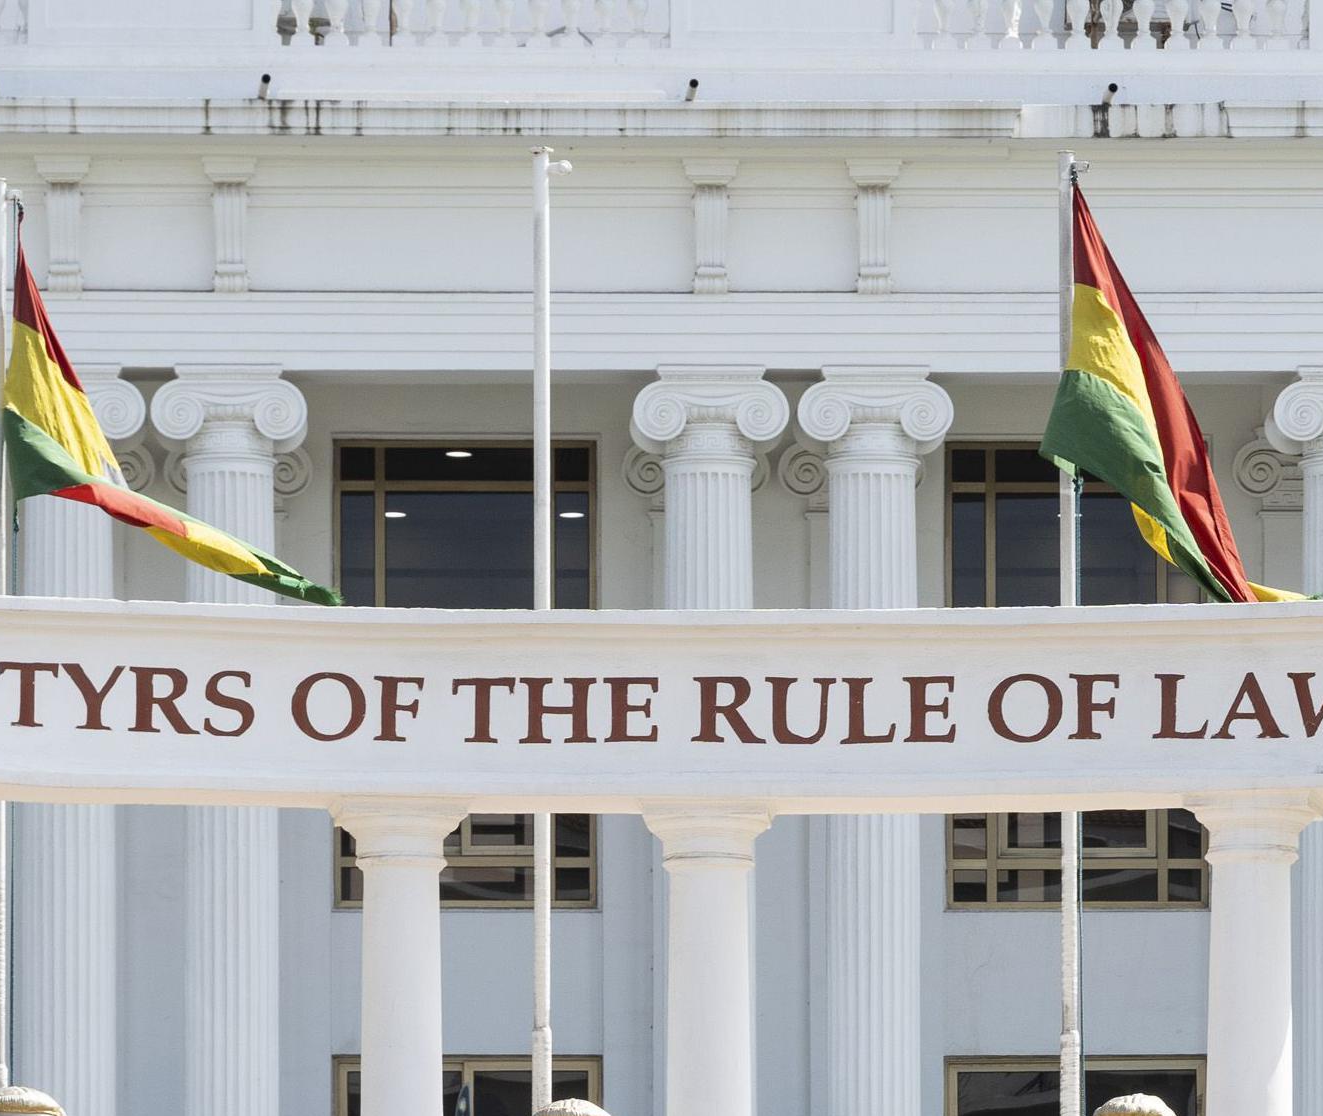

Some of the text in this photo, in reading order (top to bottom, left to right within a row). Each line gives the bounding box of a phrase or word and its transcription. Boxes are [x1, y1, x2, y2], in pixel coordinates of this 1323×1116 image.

[289, 671, 426, 743] OF
[449, 675, 661, 745] THE
[691, 674, 958, 746] RULE
[986, 672, 1121, 744] OF
